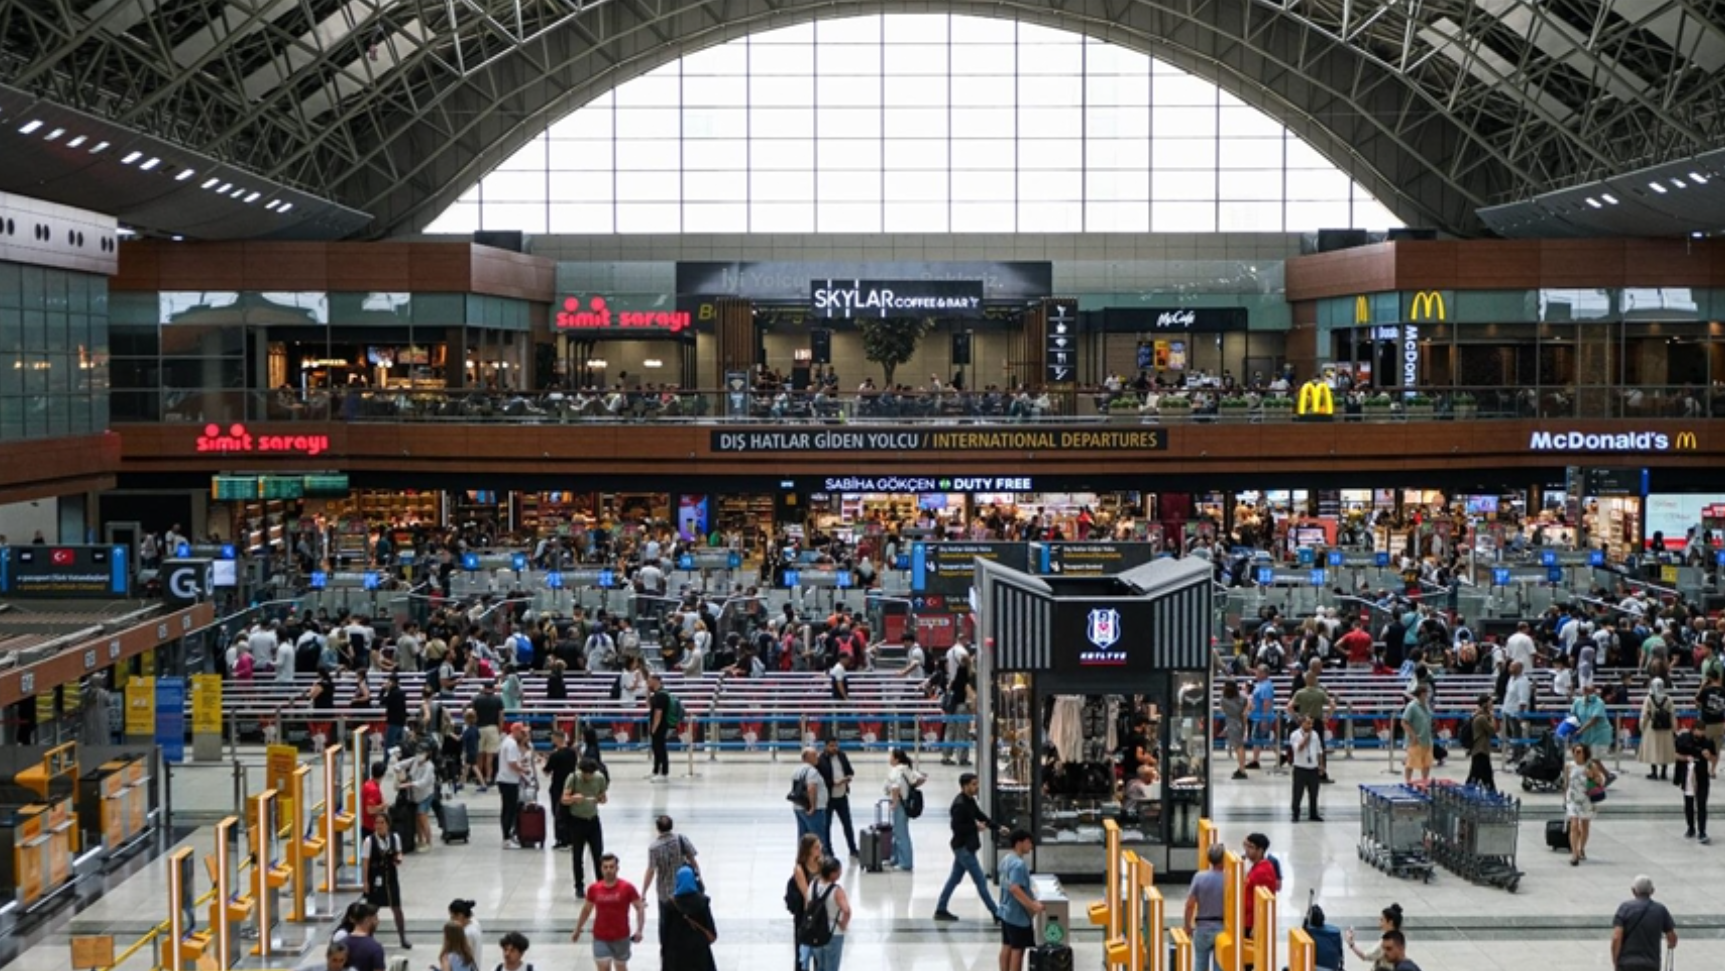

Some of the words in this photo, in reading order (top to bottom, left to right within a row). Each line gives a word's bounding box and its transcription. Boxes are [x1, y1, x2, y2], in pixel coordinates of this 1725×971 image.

[814, 287, 894, 309] SKYLAR
[557, 298, 611, 327] simit
[197, 424, 255, 453] simit
[719, 433, 747, 451] DIŞ
[750, 433, 810, 449] HATLAR
[814, 430, 864, 449] GİDEN
[867, 433, 919, 449] YOLCU
[932, 432, 1057, 449] INTERNATIONAL
[1060, 432, 1158, 449] DEPARTURES
[1530, 431, 1669, 450] McDonald's
[825, 477, 875, 490] SABİHA
[877, 477, 936, 493] GÖKÇEN
[953, 478, 993, 490] DUTY
[995, 478, 1032, 490] FREE
[169, 567, 198, 598] G
